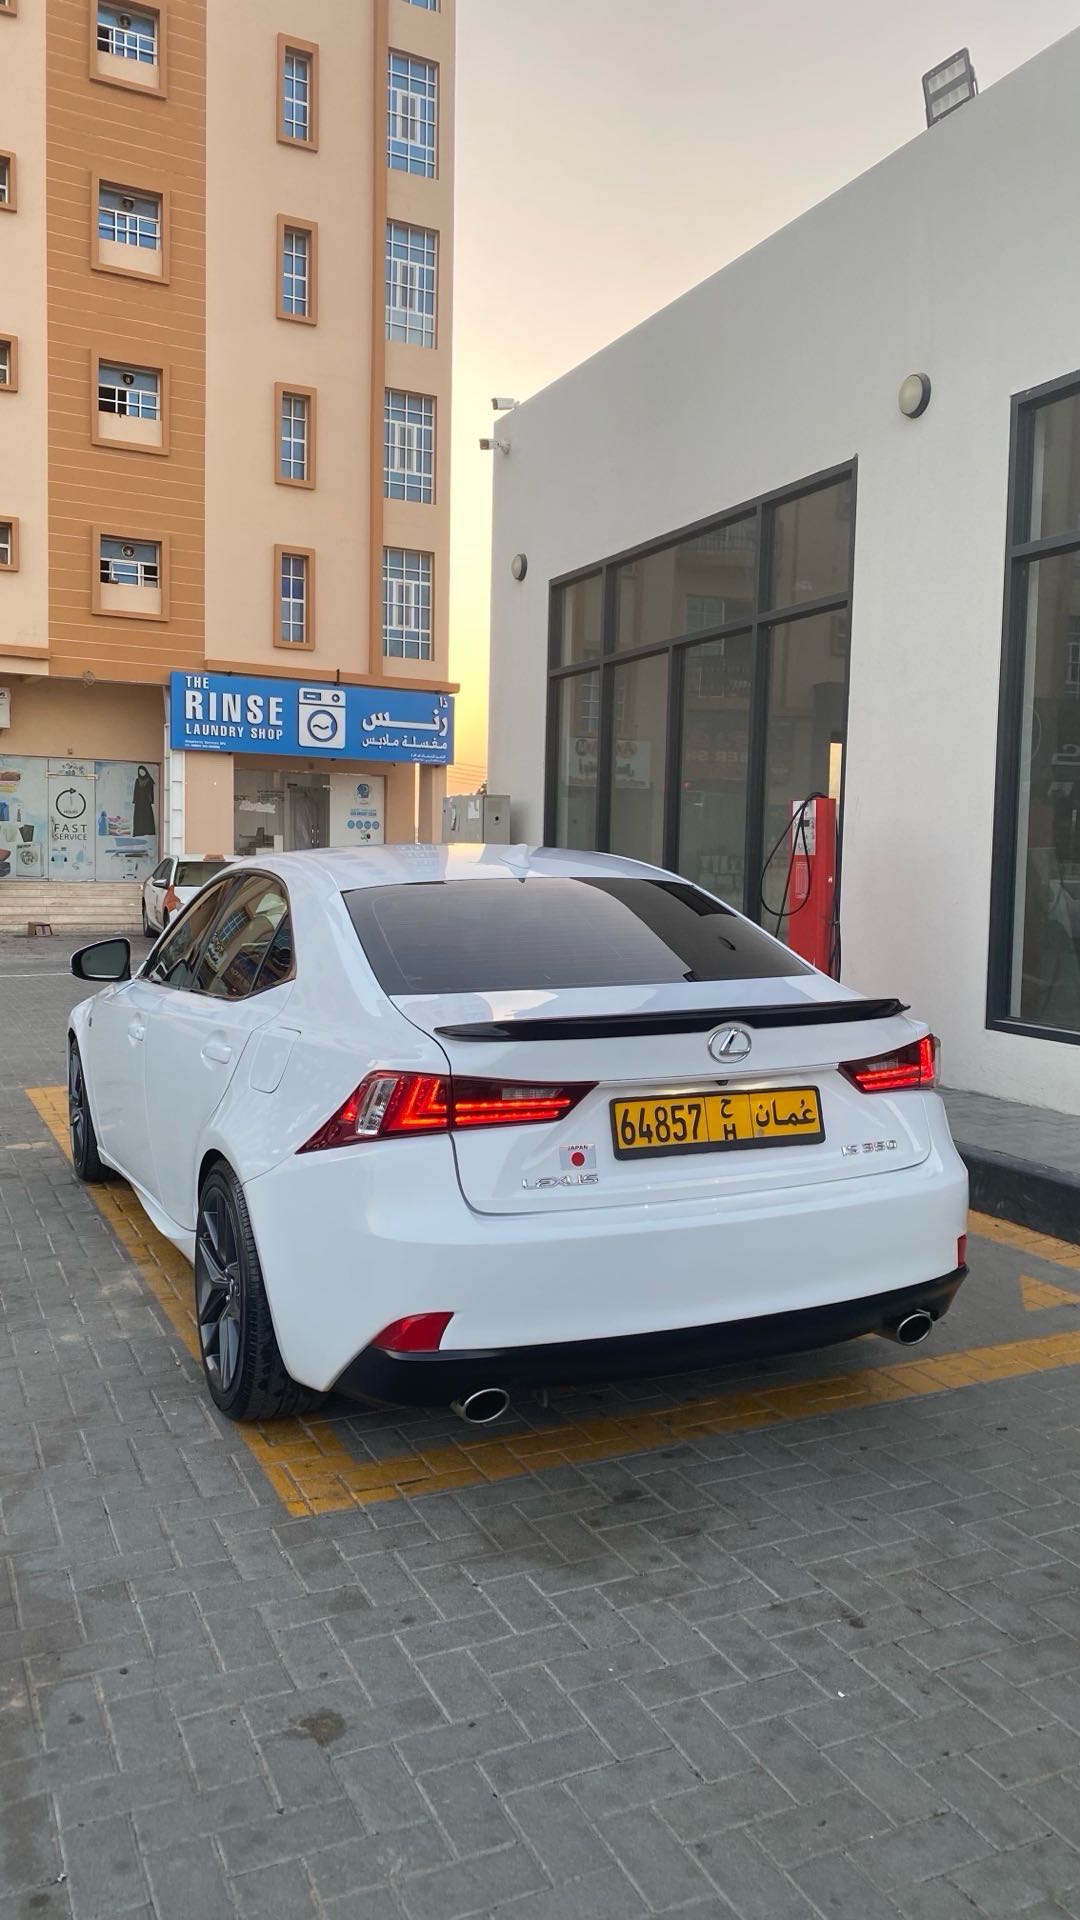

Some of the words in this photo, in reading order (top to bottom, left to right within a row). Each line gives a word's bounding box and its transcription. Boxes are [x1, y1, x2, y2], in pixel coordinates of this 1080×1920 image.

[186, 676, 209, 689] THE
[185, 690, 283, 726] RINSE
[439, 696, 448, 709] ذا
[185, 723, 244, 738] LAUNDRY
[250, 728, 283, 740] SHOP
[362, 733, 399, 749] ملابس
[402, 735, 448, 750] مغسلة
[54, 823, 87, 833] FAST
[54, 833, 88, 841] SERVICE
[720, 1098, 734, 1119] ح
[620, 1103, 702, 1146] 64857
[723, 1123, 737, 1141] H
[841, 1145, 858, 1157] IS
[862, 1139, 897, 1153] 350
[522, 1174, 599, 1190] LEXUS
